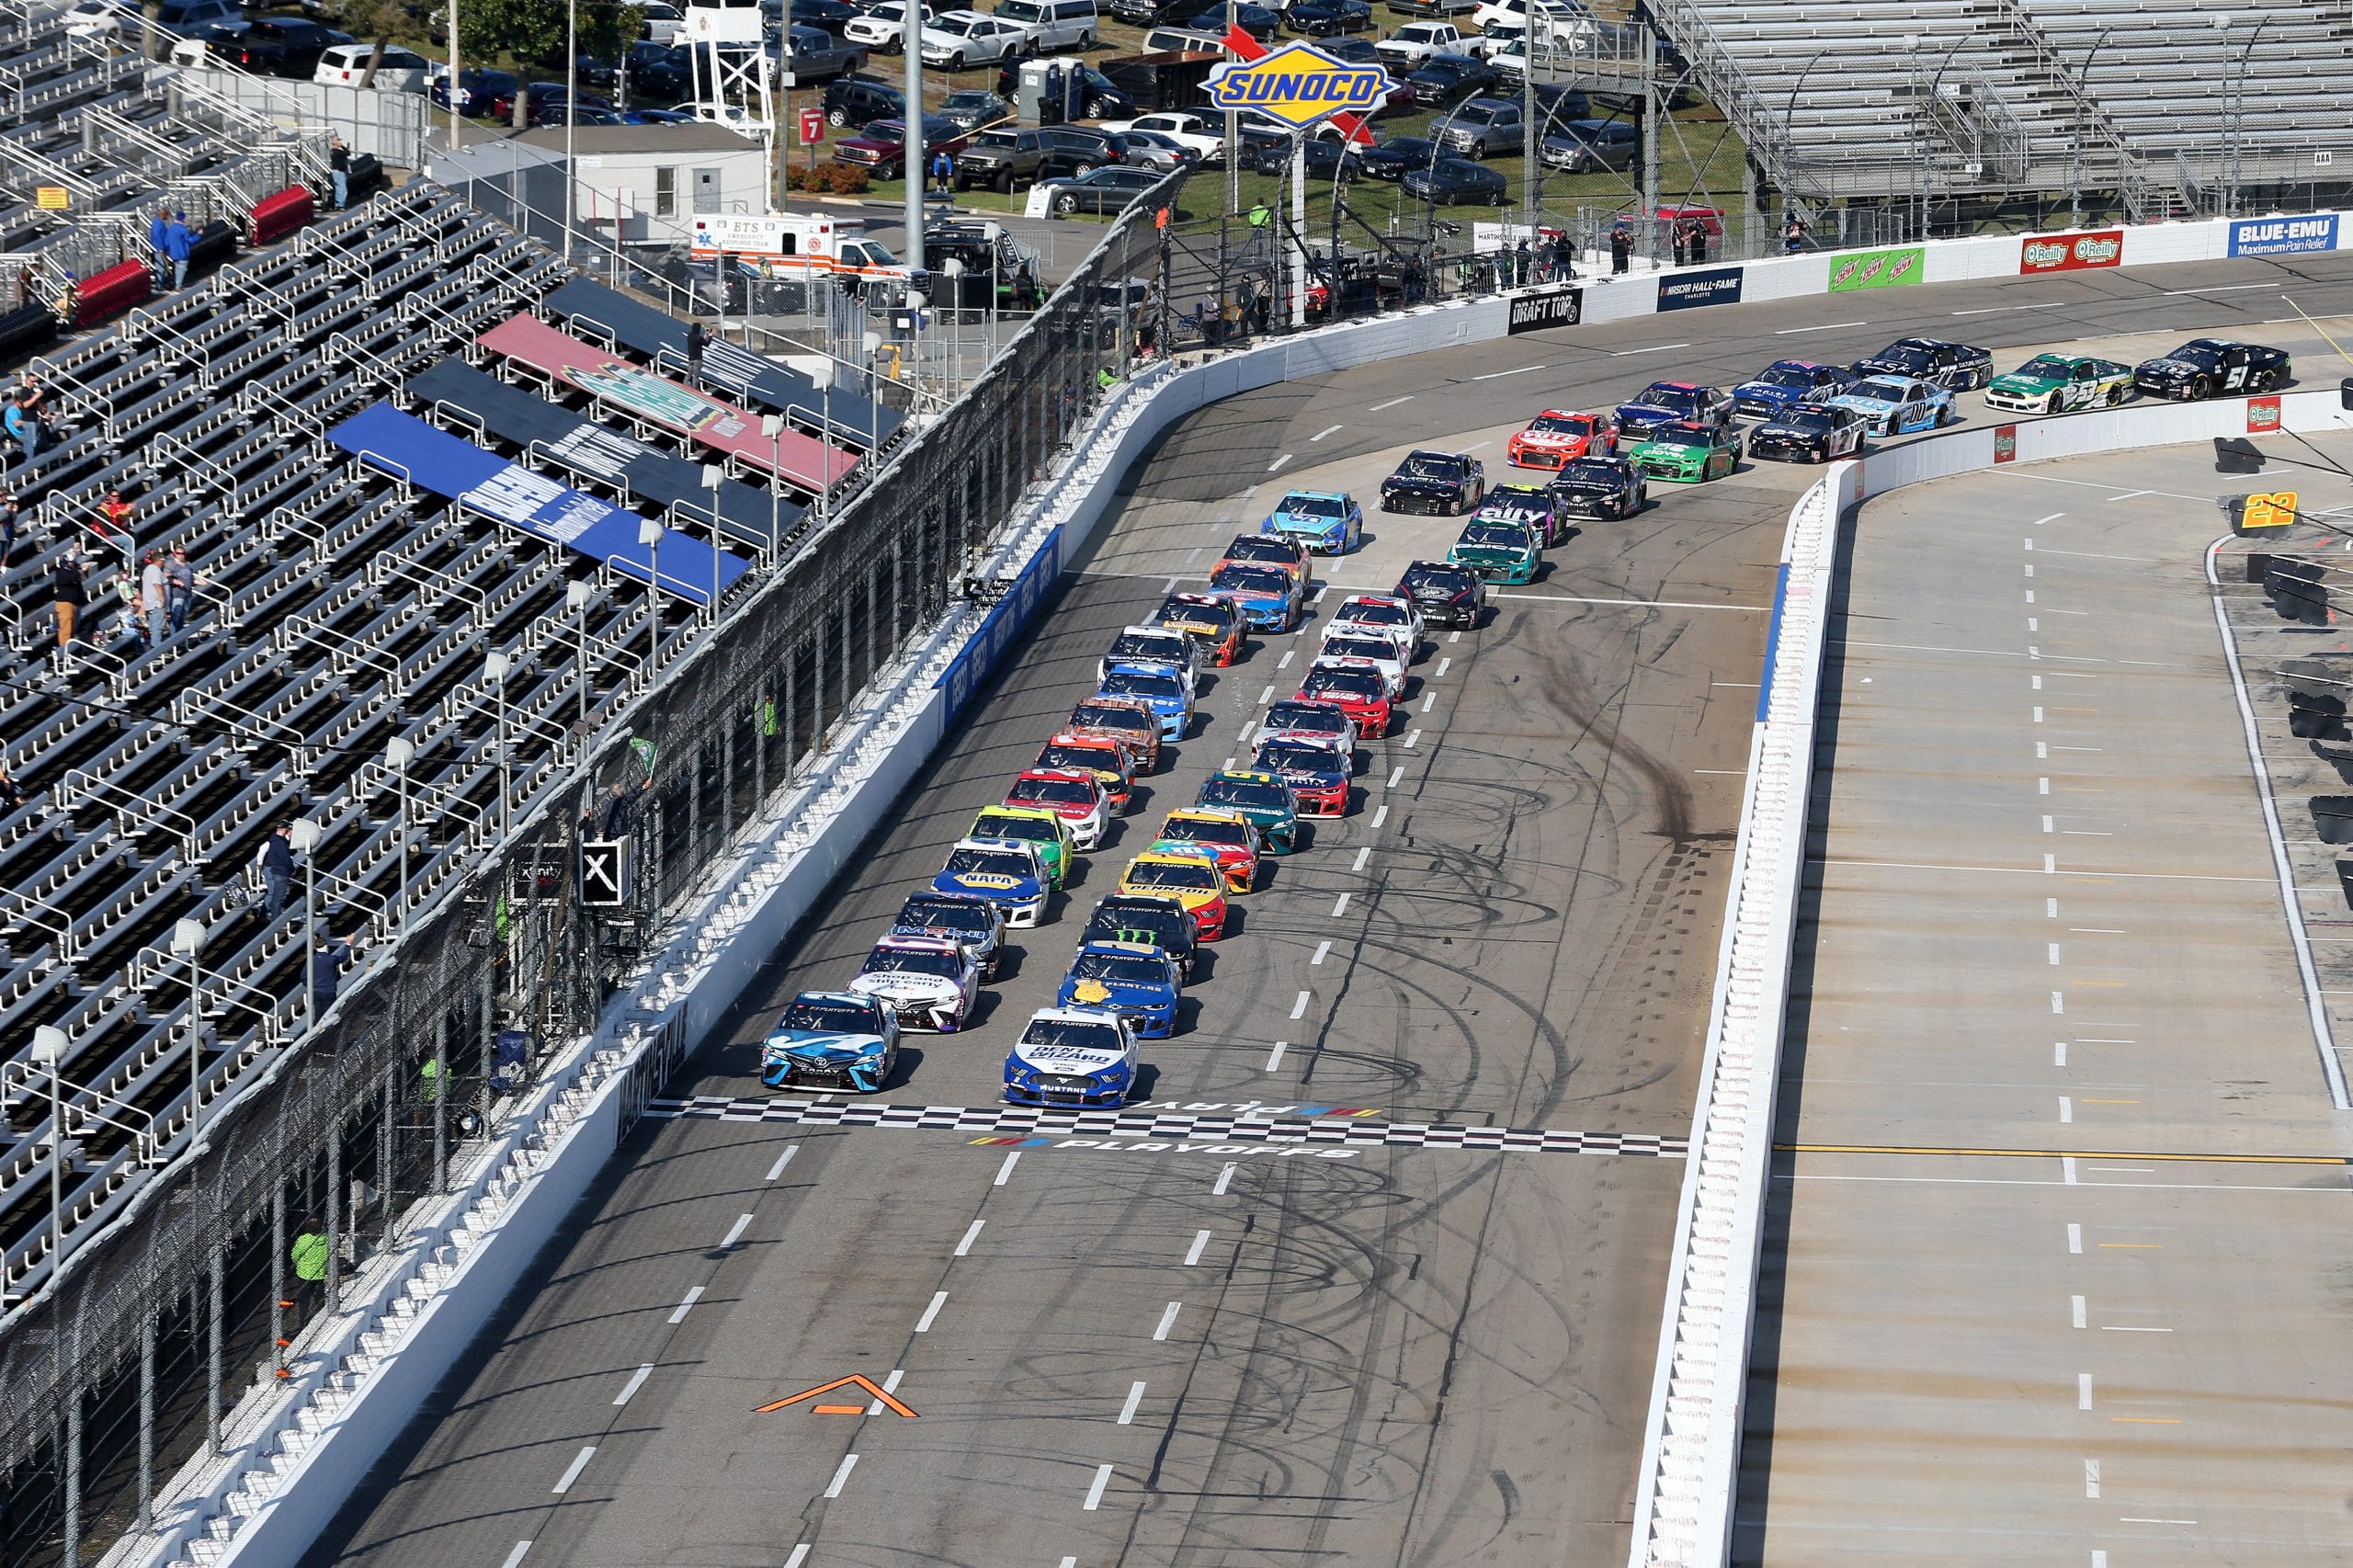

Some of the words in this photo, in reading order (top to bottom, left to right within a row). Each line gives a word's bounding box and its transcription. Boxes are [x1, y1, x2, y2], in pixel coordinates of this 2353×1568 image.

[1222, 74, 1377, 101] SUNOCO
[809, 121, 818, 139] 7
[2315, 153, 2330, 163] AAA
[733, 222, 759, 232] ETS
[2238, 220, 2331, 243] BLUE-EMU
[2026, 244, 2067, 263] O'Reilly
[2076, 240, 2119, 258] O'Reilly
[2237, 243, 2286, 256] Maximum
[2286, 239, 2305, 252] Pain
[2305, 237, 2328, 250] Relief
[1667, 283, 1692, 296] NASCAR
[1692, 280, 1712, 292] HALL
[1715, 278, 1738, 290] FAME
[1684, 291, 1711, 300] CHARLOTTE
[1513, 298, 1551, 324] DRAFT
[1551, 295, 1574, 318] TOP
[1937, 365, 1958, 386] 77
[2223, 365, 2248, 390] 51
[2075, 380, 2098, 403] 53
[1908, 402, 1927, 424] 00
[2249, 407, 2279, 422] O'Reilly
[1521, 430, 1581, 445] VOTE
[1643, 449, 1687, 460] clover
[462, 463, 567, 524] BLUE-EMU
[1480, 507, 1548, 522] ally
[2242, 491, 2299, 528] 22
[1455, 543, 1527, 553] GEICO
[583, 853, 619, 892] X
[965, 874, 1012, 885] NAPA
[1130, 885, 1211, 895] PENNZOIL
[897, 926, 985, 939] Mobil
[904, 980, 943, 989] early
[1105, 981, 1163, 993] PLANTERS
[1028, 1051, 1111, 1062] WIZARD
[1040, 1085, 1087, 1094] MUSTANG
[1052, 1139, 1361, 1159] PLAYOFFS
